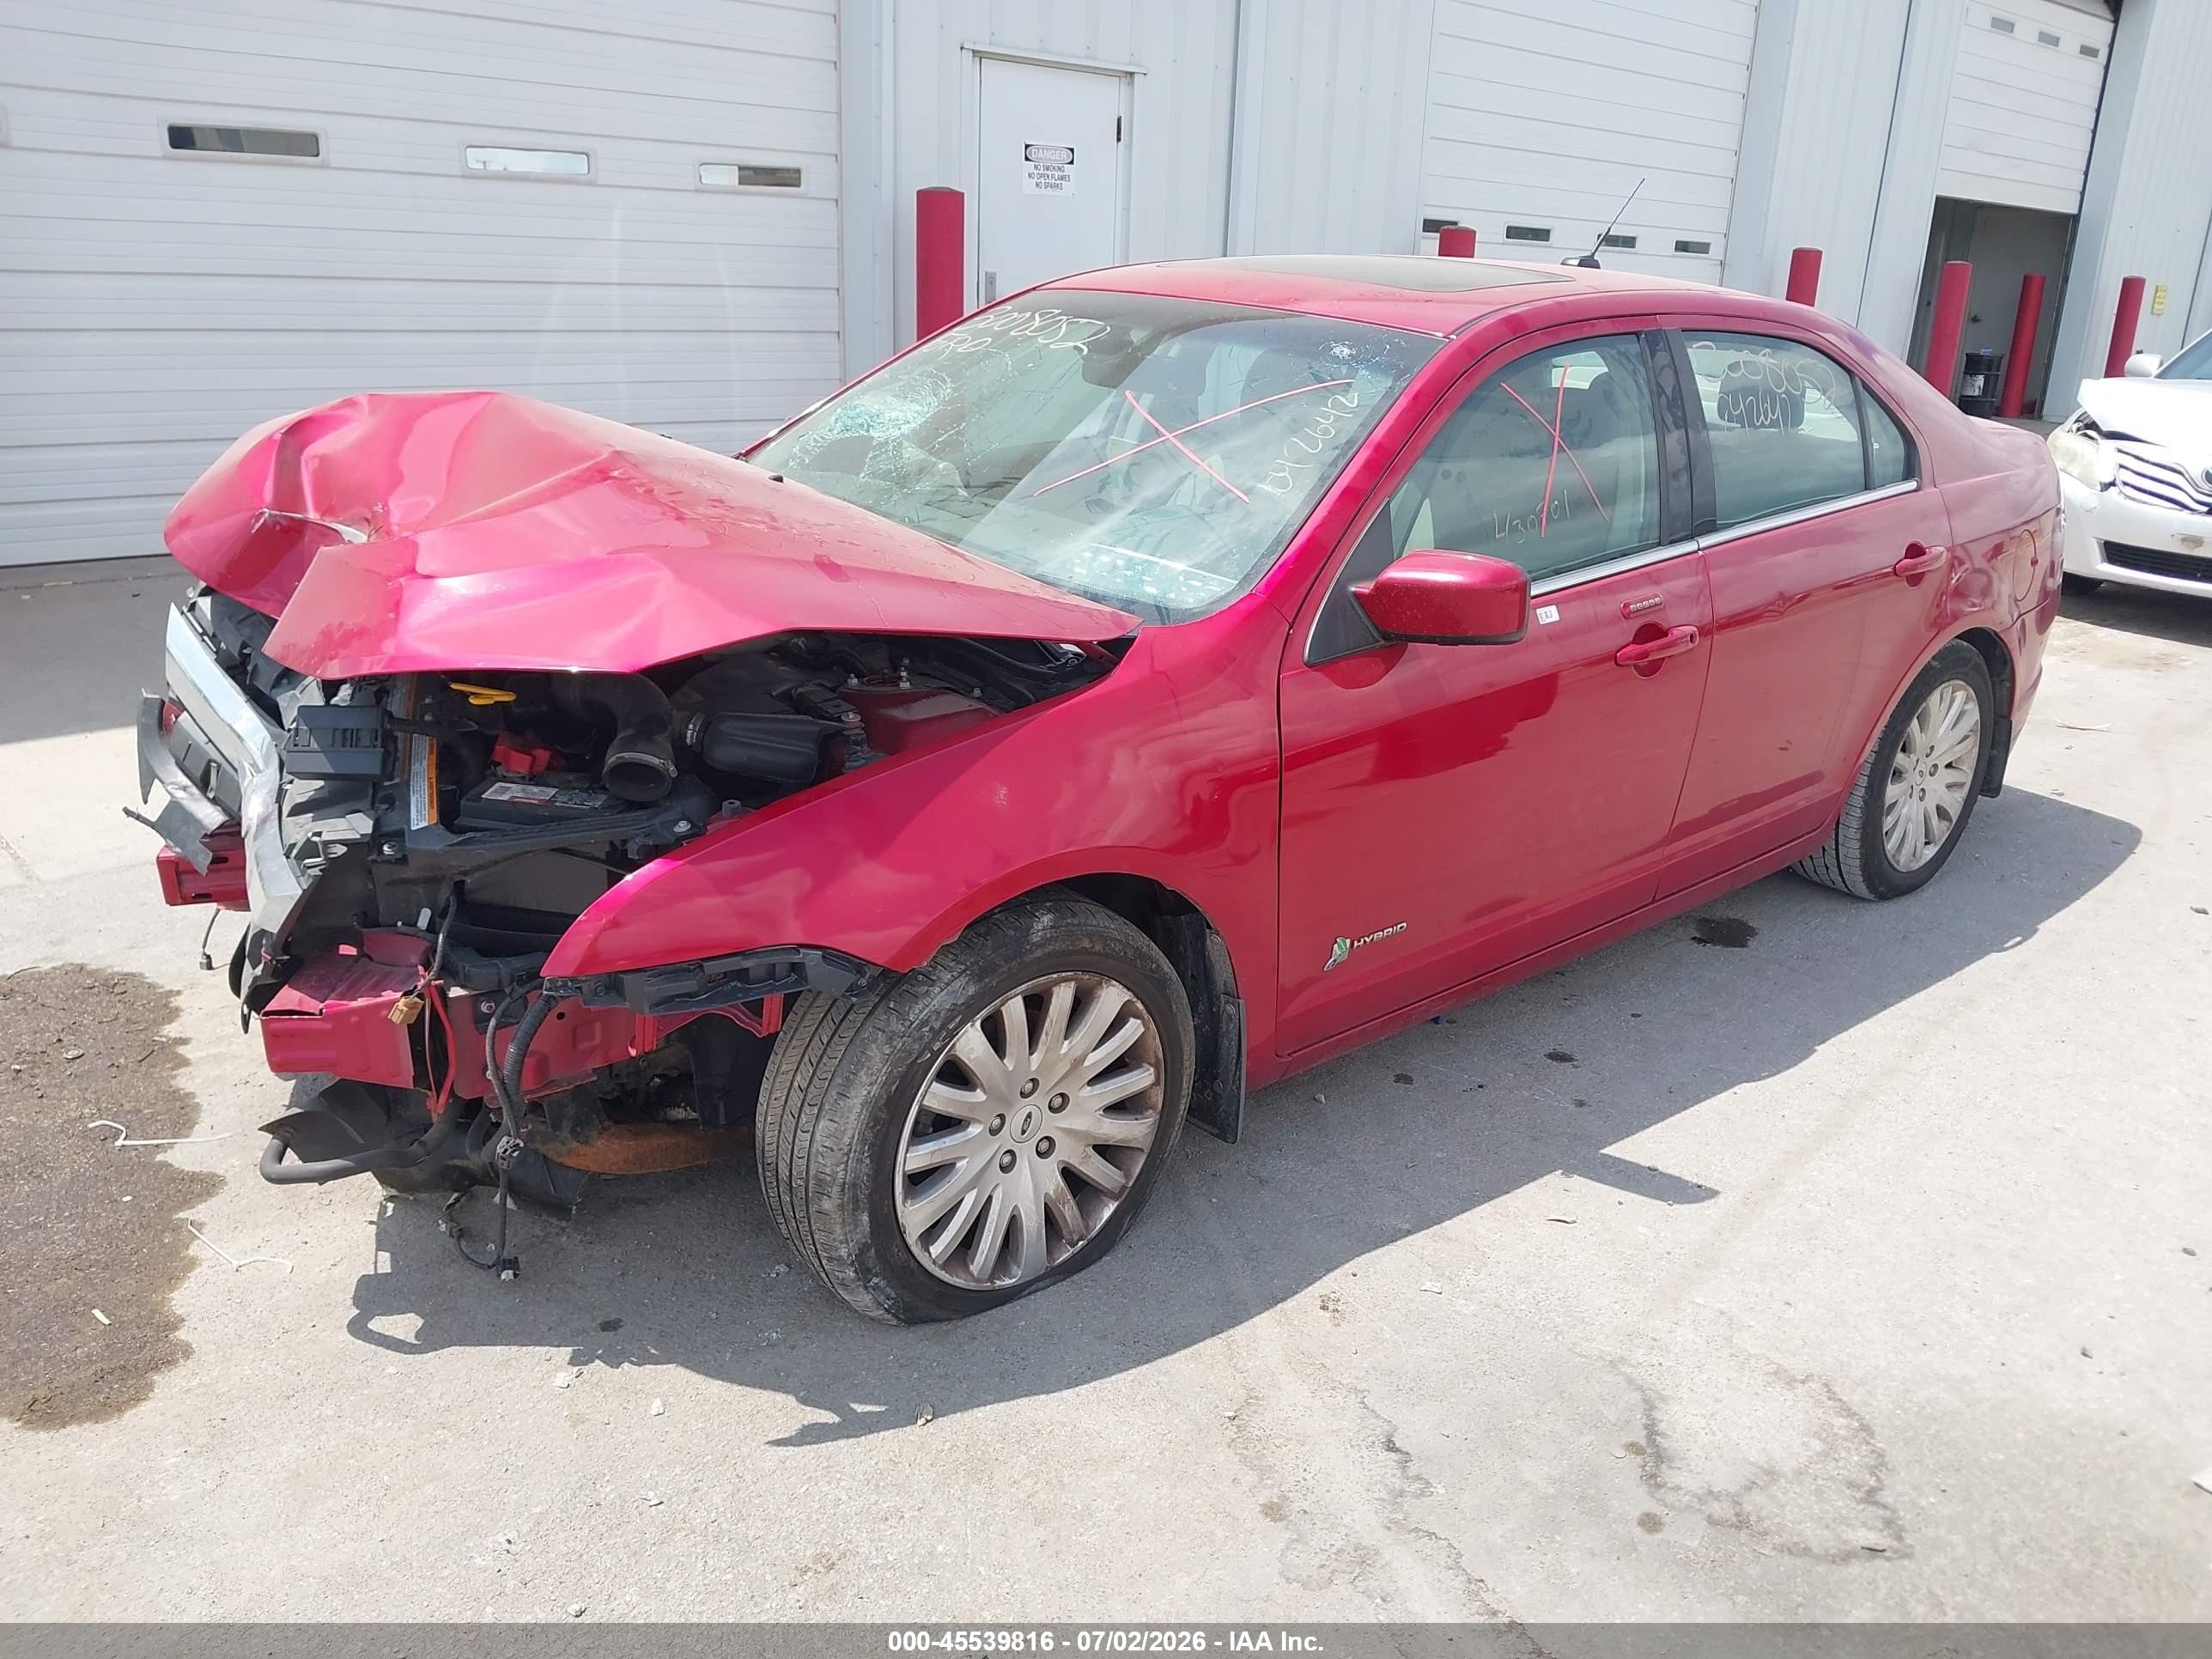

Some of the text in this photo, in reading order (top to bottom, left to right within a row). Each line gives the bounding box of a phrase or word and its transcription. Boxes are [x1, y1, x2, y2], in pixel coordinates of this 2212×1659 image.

[1031, 149, 1066, 161] DANGER
[1042, 164, 1066, 173] SMOKING
[1036, 173, 1049, 181] OPEN
[1051, 173, 1071, 182] FLAMES
[1036, 180, 1063, 191] NO SPARKS
[1352, 921, 1407, 950] HYBRID
